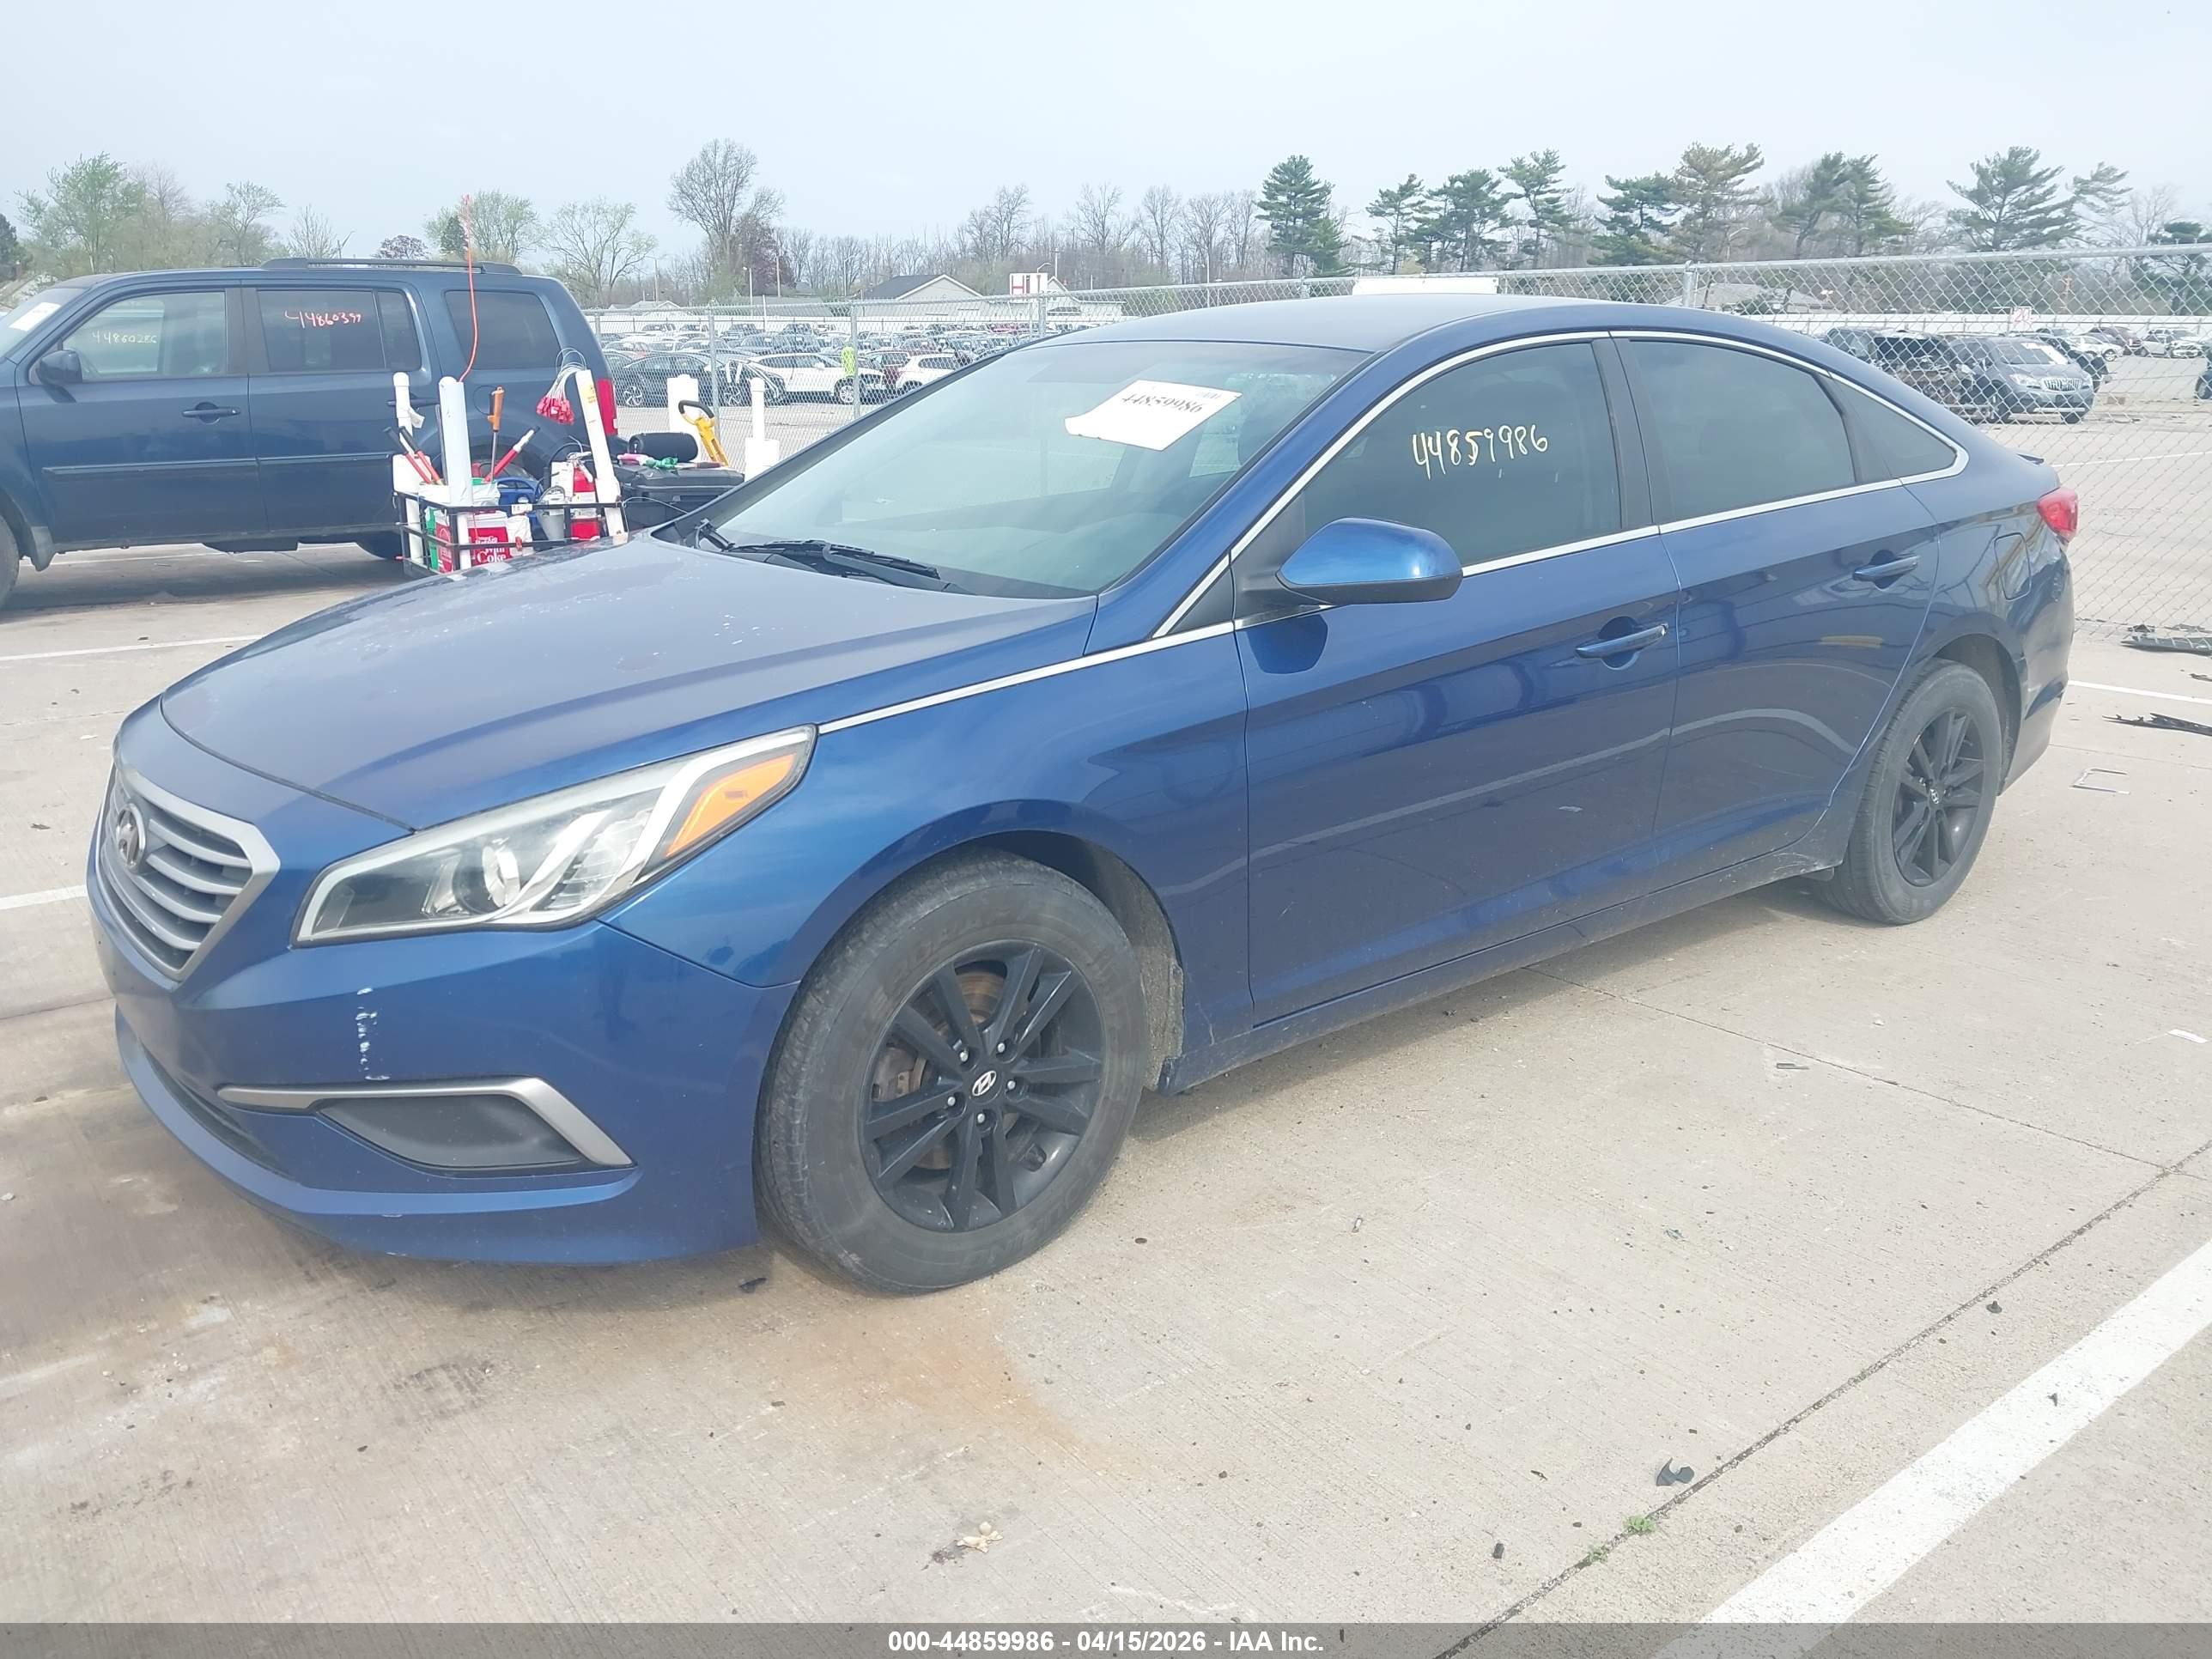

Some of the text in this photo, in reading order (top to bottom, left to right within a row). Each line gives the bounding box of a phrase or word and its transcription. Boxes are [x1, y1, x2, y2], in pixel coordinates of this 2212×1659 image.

[1121, 392, 1203, 413] 44859986
[1413, 424, 1548, 480] 44859986
[477, 551, 507, 563] Coke
